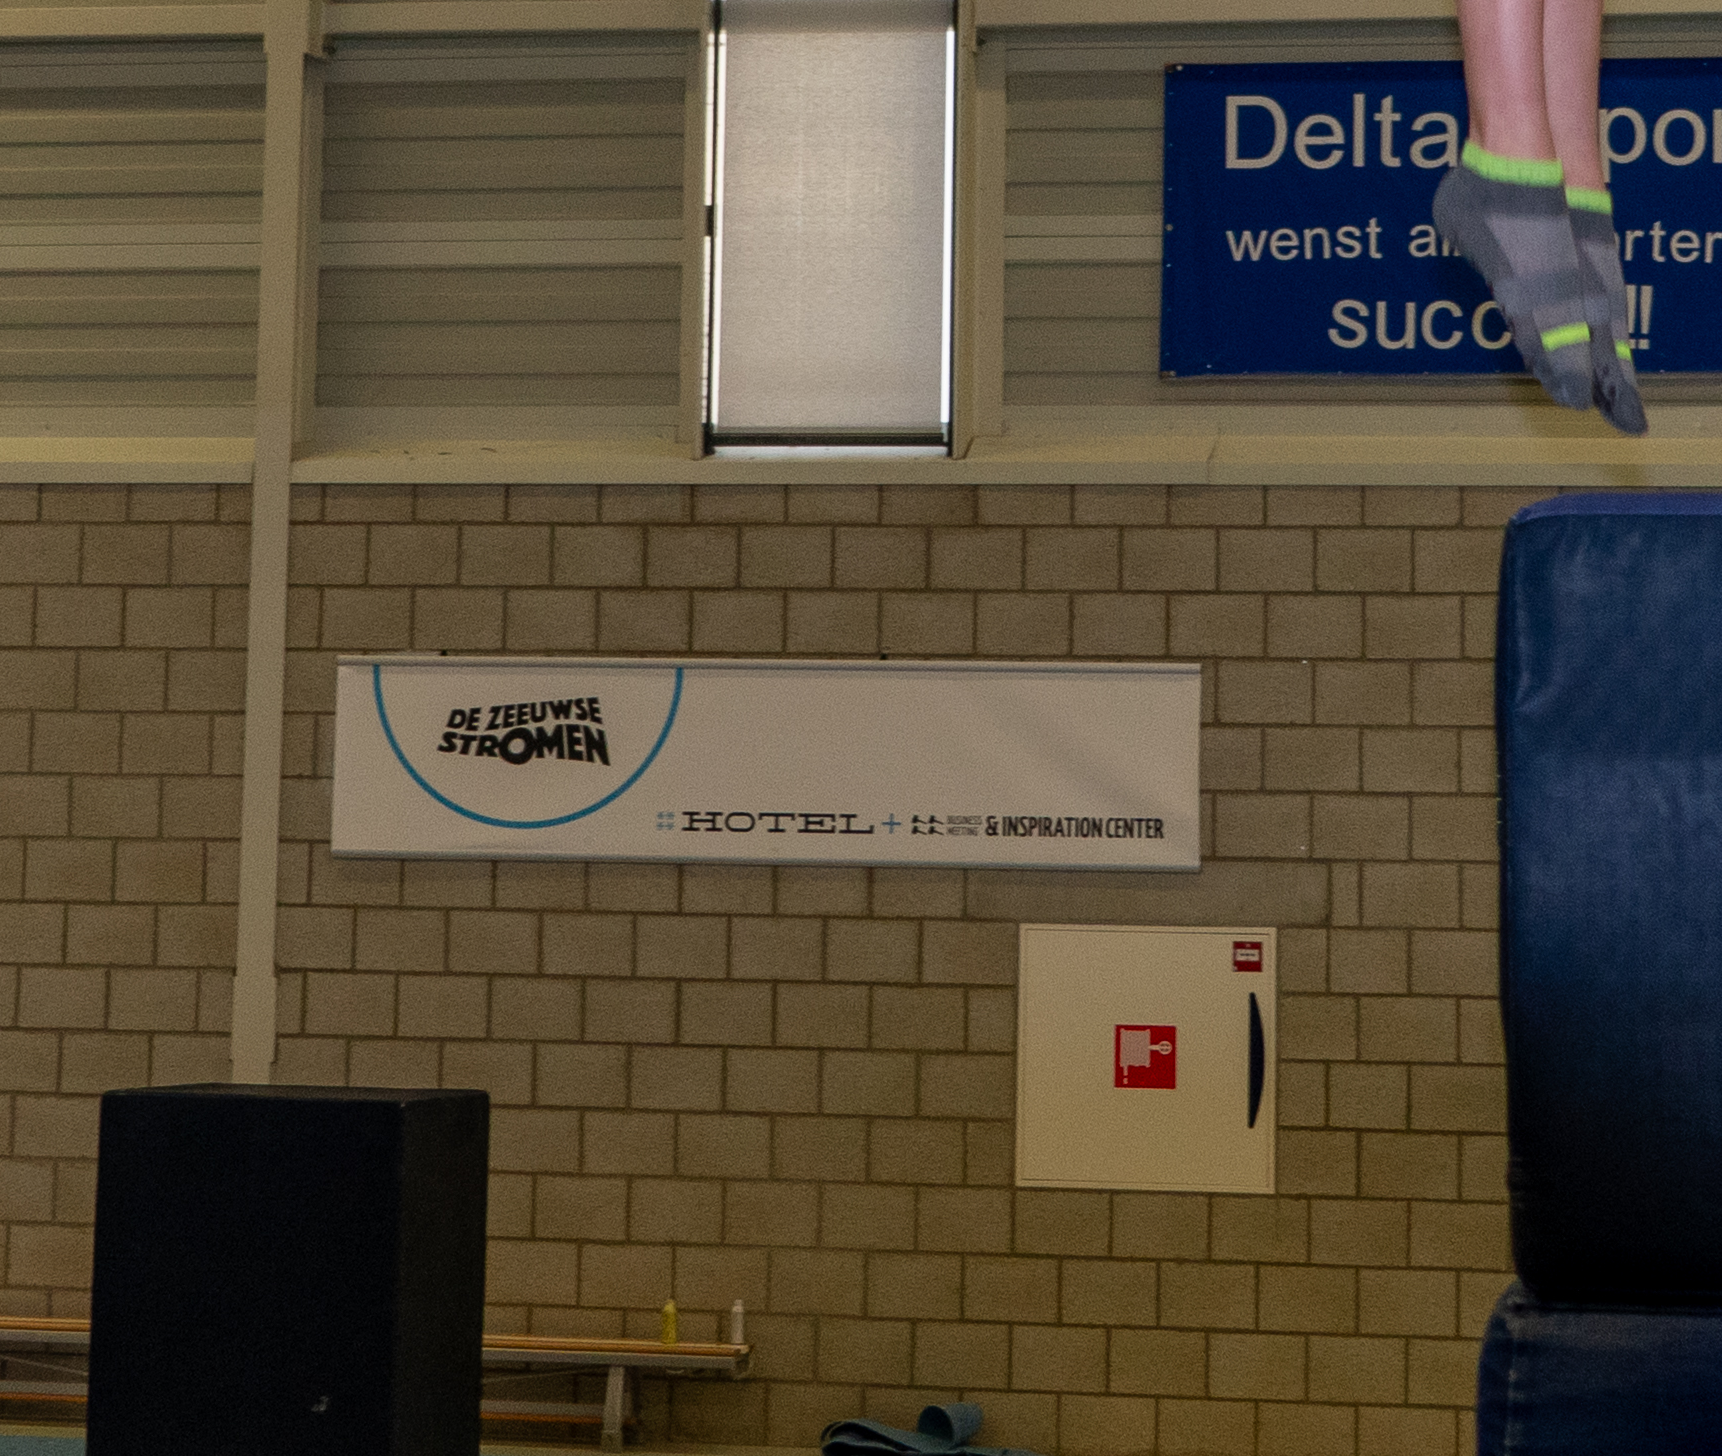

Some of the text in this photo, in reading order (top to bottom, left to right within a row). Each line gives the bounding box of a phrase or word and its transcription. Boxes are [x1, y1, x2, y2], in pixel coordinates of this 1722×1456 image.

[1223, 93, 1460, 169] Delta
[1225, 217, 1383, 262] wenst
[446, 696, 604, 732] DE ZEEUWSE
[437, 723, 611, 766] STROMEN
[681, 811, 875, 835] HOTEL
[985, 815, 1000, 837] &
[1002, 815, 1103, 839] INSPIRATION
[1105, 817, 1164, 840] CENTER
